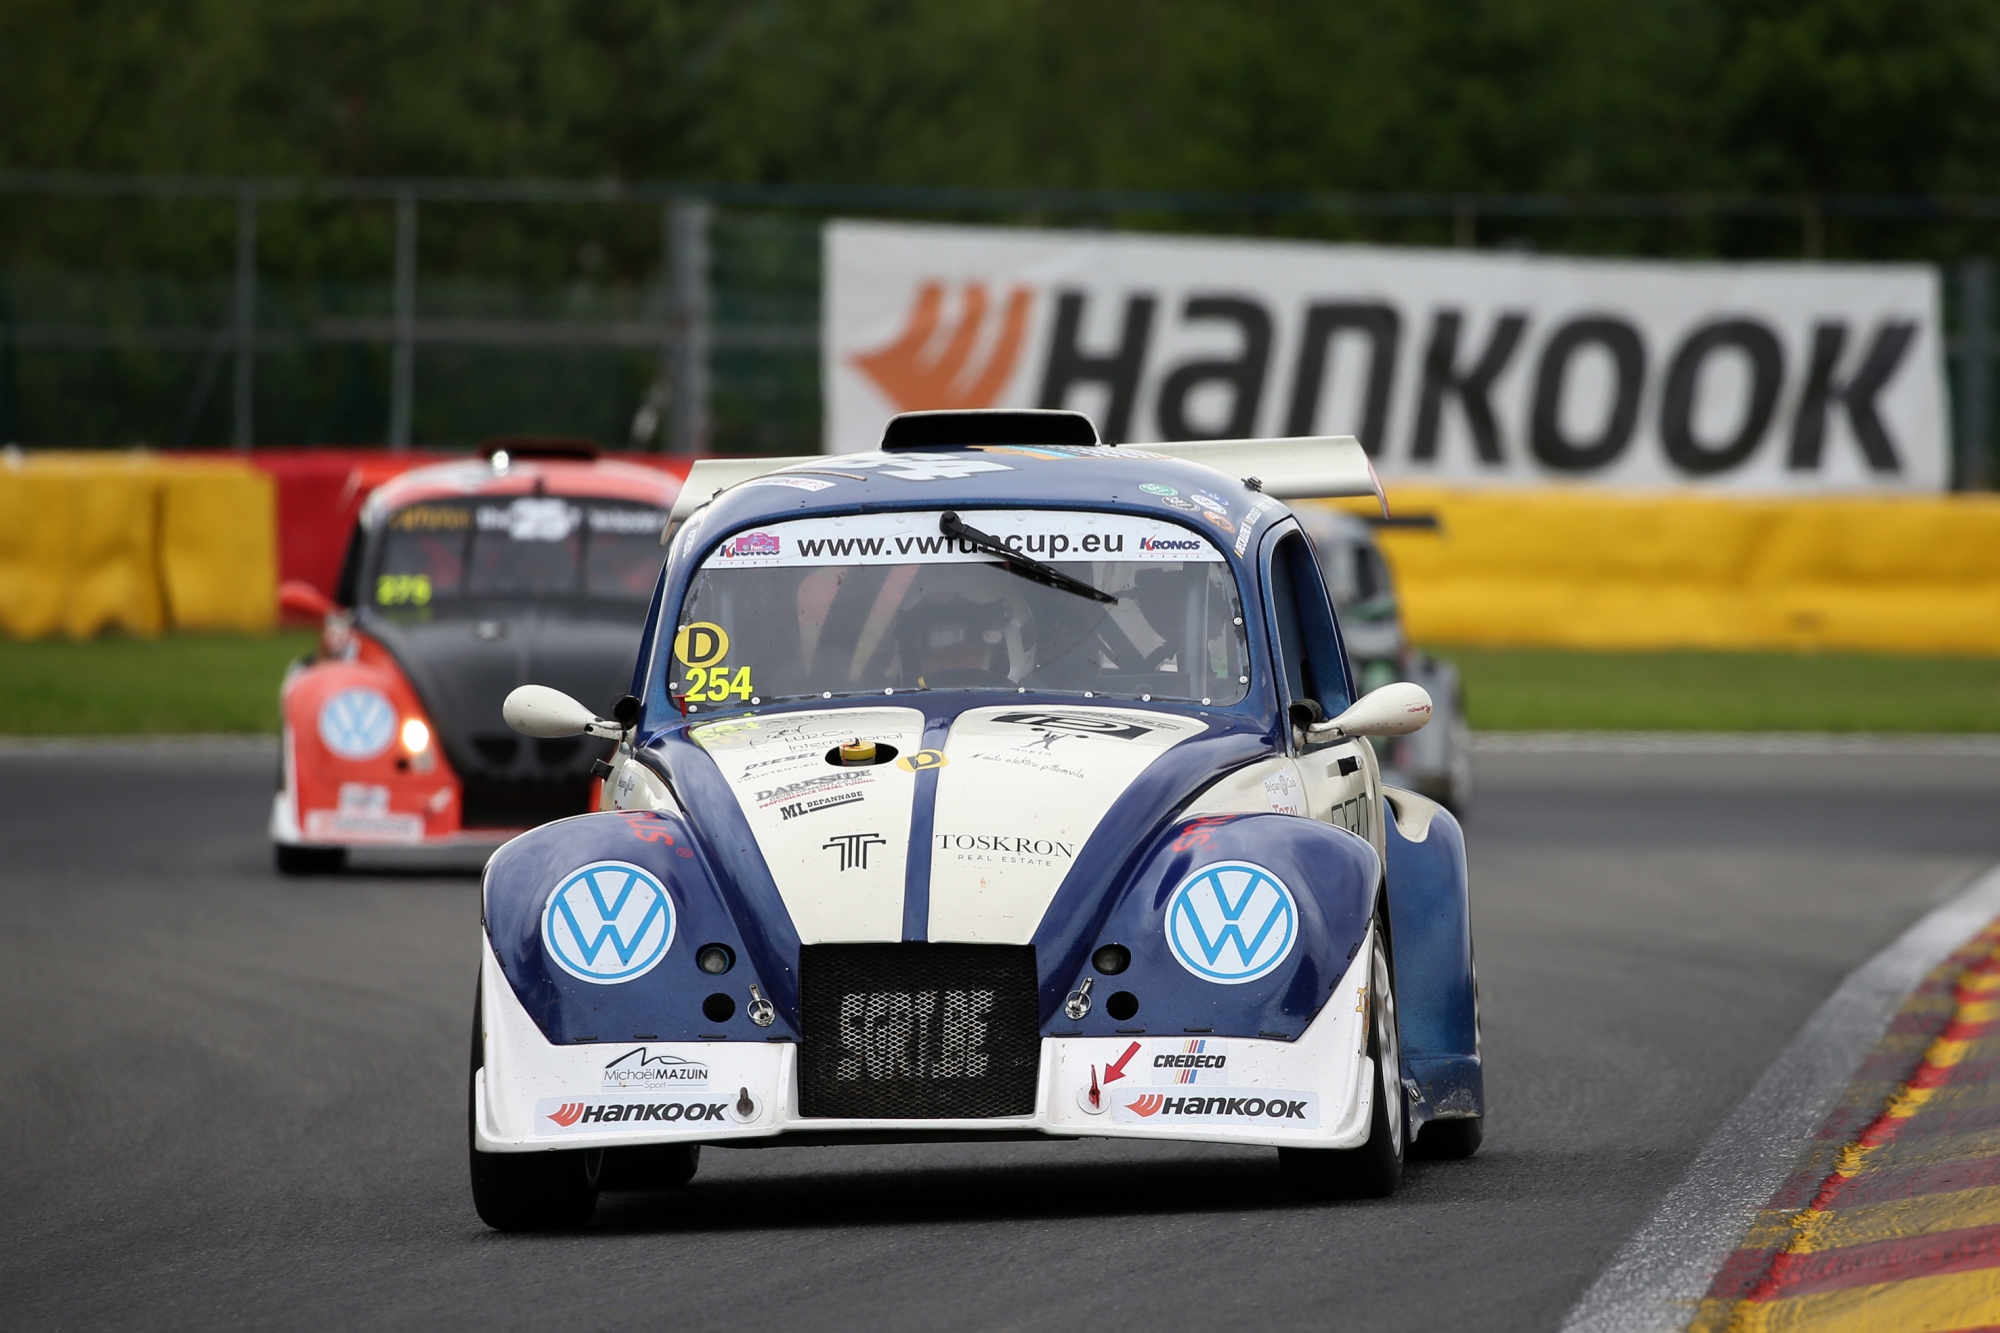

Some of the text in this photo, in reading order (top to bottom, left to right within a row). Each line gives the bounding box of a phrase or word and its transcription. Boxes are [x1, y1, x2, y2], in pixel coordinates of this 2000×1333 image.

[687, 627, 720, 663] D
[684, 666, 753, 702] 254
[754, 769, 873, 802] DARKSIDE
[780, 790, 864, 821] ML DEPANNAGE
[935, 835, 1075, 859] TOSKRON
[958, 854, 1052, 867] REAL ESTATE
[1153, 1054, 1226, 1069] CREDECO
[644, 1081, 667, 1092] Sport
